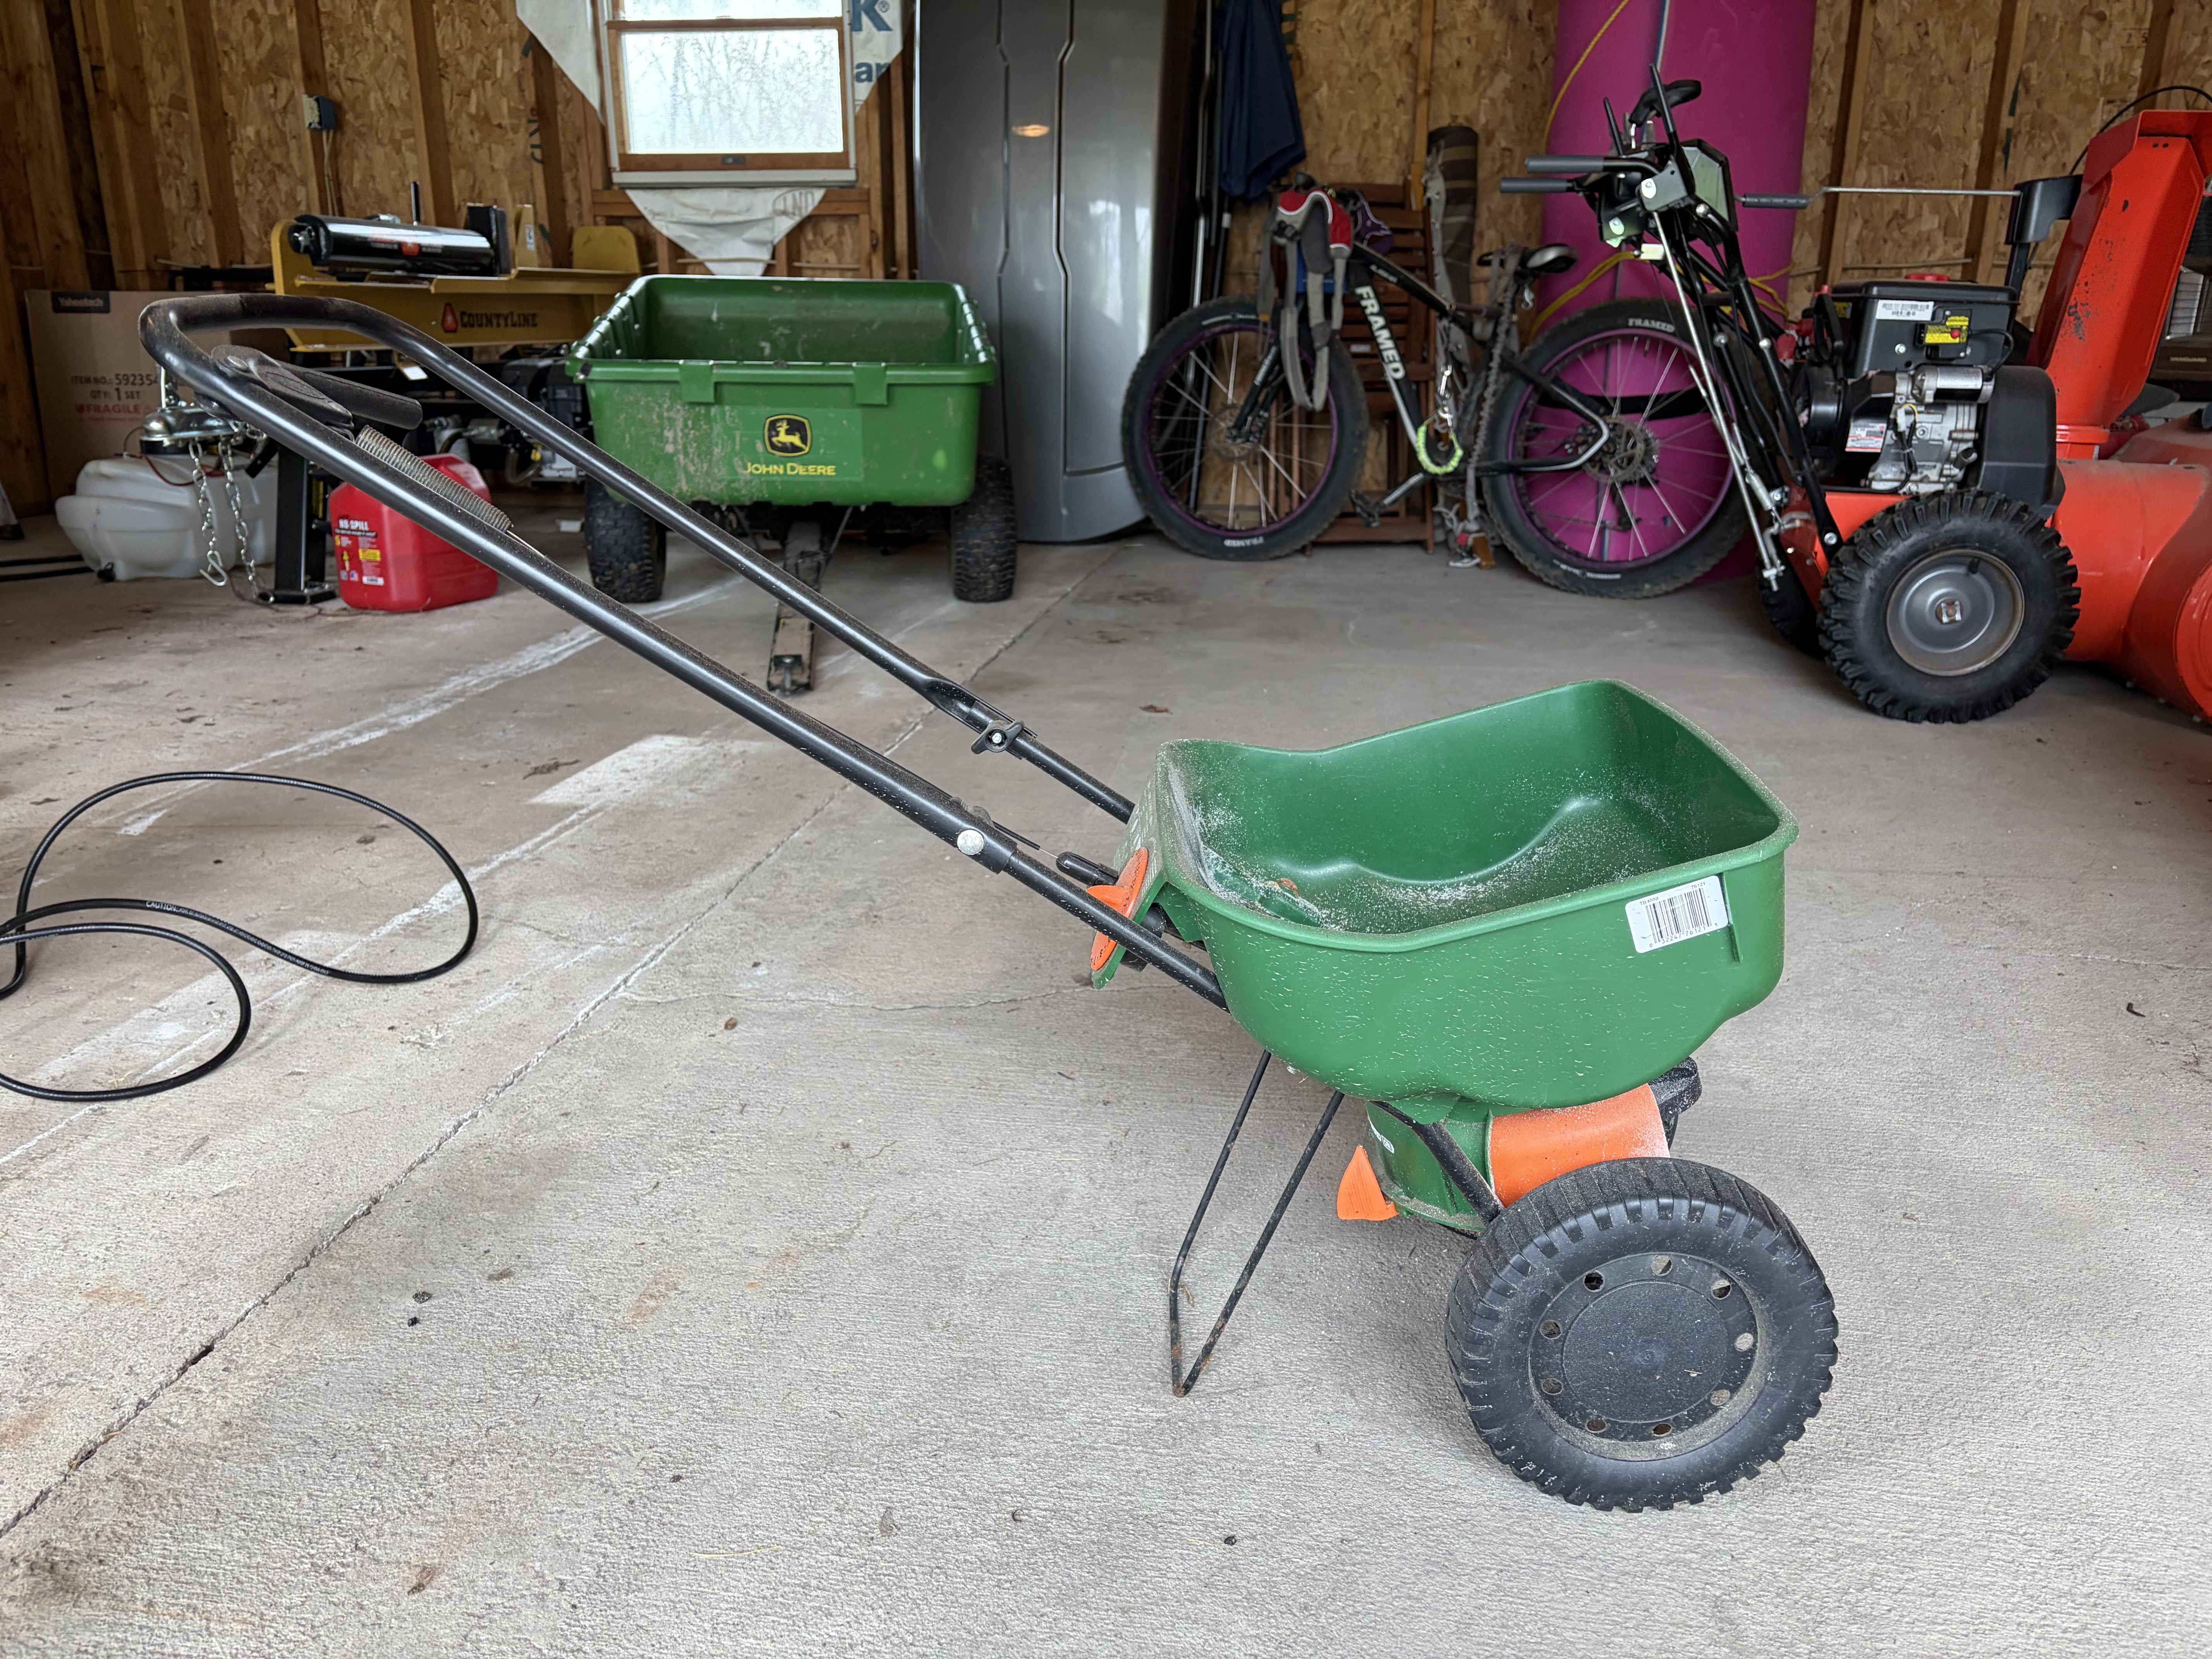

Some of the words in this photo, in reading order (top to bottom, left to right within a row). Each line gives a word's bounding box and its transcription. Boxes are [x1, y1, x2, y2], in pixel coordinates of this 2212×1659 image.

[1355, 285, 1405, 380] FRAMED
[1628, 318, 1676, 333] FRAMED
[71, 375, 91, 385] ITEM
[115, 387, 121, 401] 1
[124, 390, 140, 400] SET
[87, 404, 141, 414] FRAGILE
[746, 461, 784, 475] JOHN
[786, 462, 837, 476] DEERE
[1223, 536, 1265, 548] FRAMED
[1662, 931, 1682, 944] 32247
[1685, 926, 1706, 937] 76121
